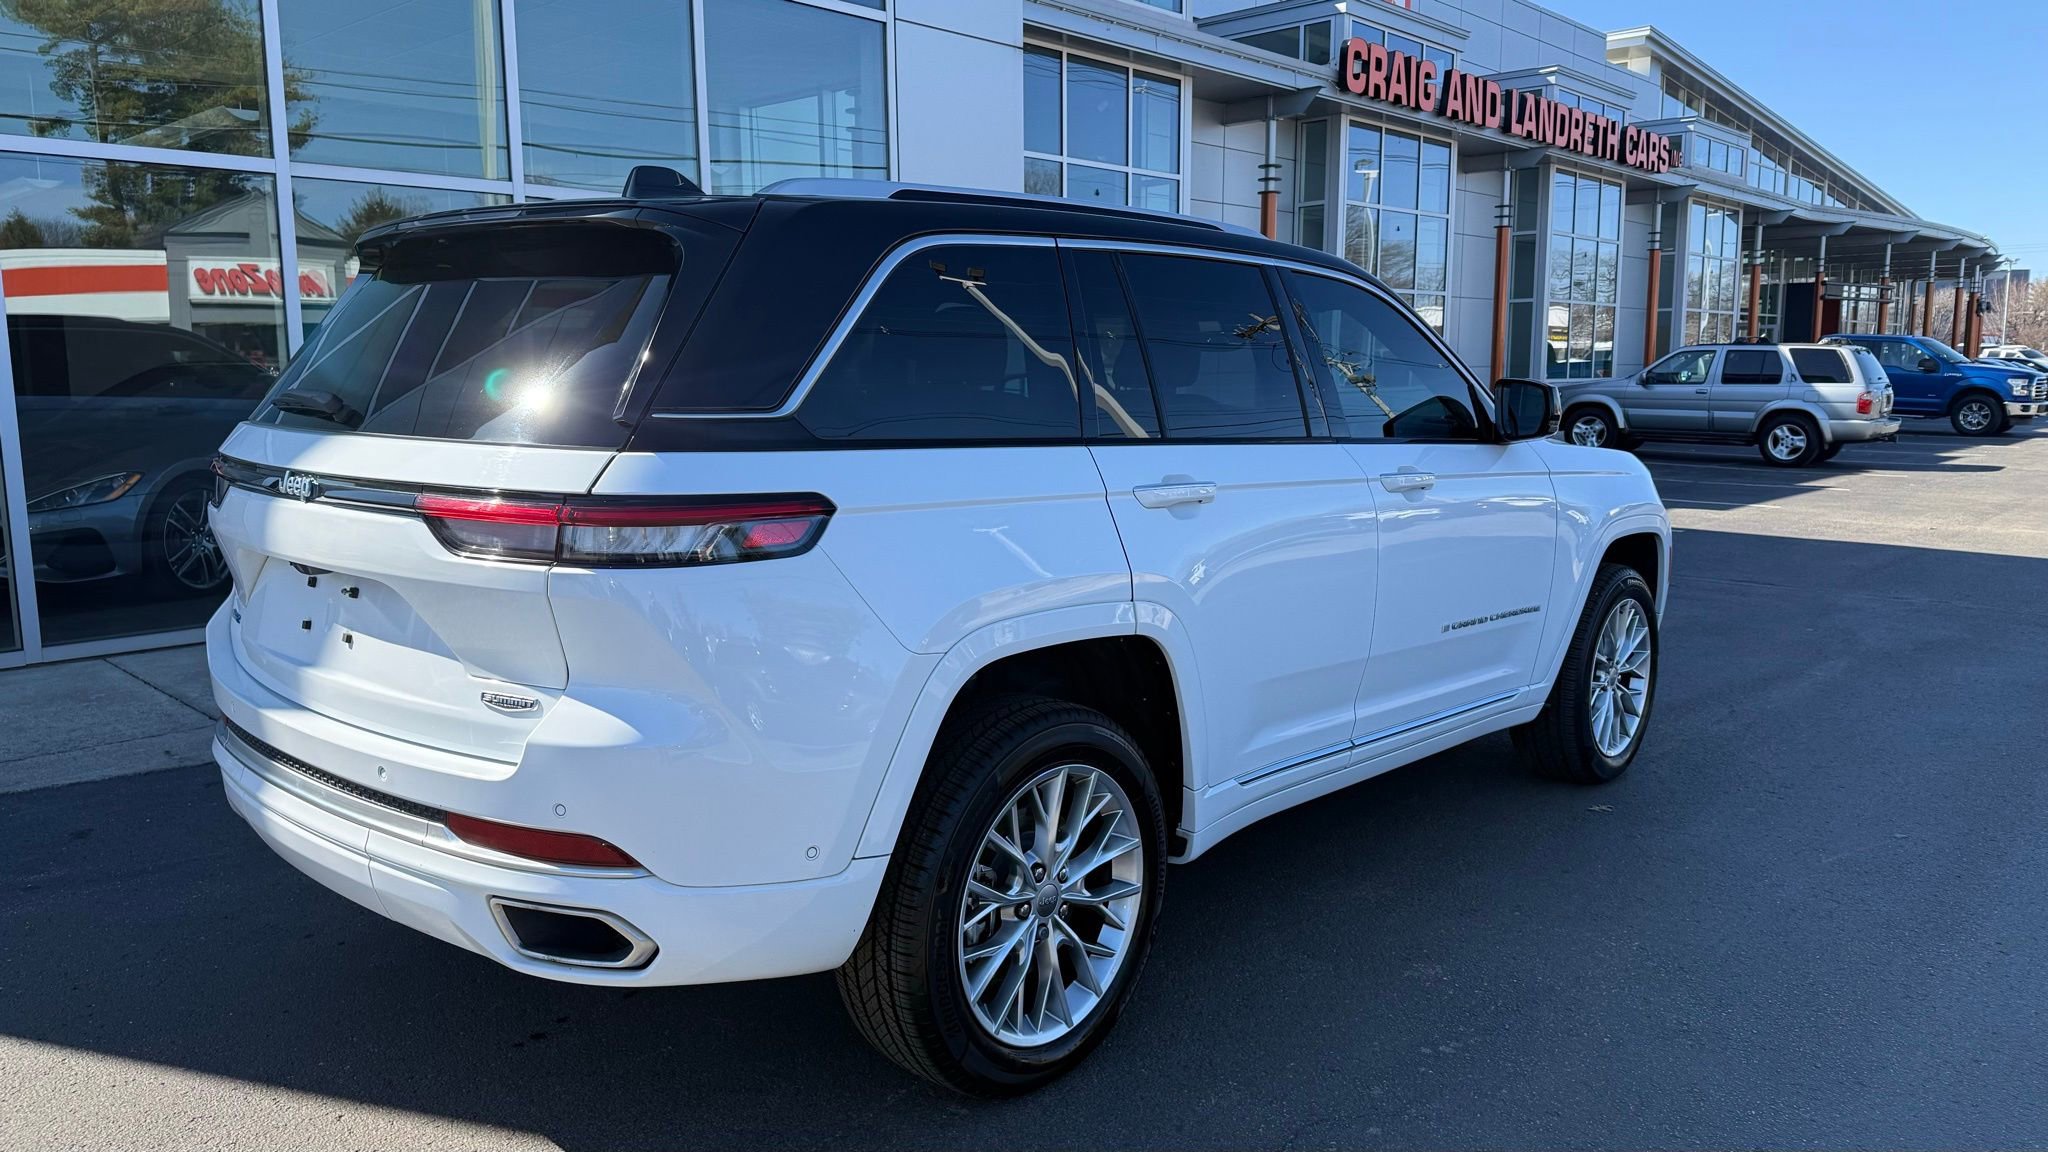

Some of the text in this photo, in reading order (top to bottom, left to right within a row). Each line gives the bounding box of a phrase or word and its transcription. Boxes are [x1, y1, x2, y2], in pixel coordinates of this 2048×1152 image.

[1345, 37, 1437, 112] CRAIG
[1445, 69, 1501, 129] AND
[1510, 88, 1620, 160] LANDRETH
[1625, 125, 1669, 173] CARS
[279, 470, 312, 502] Jeep
